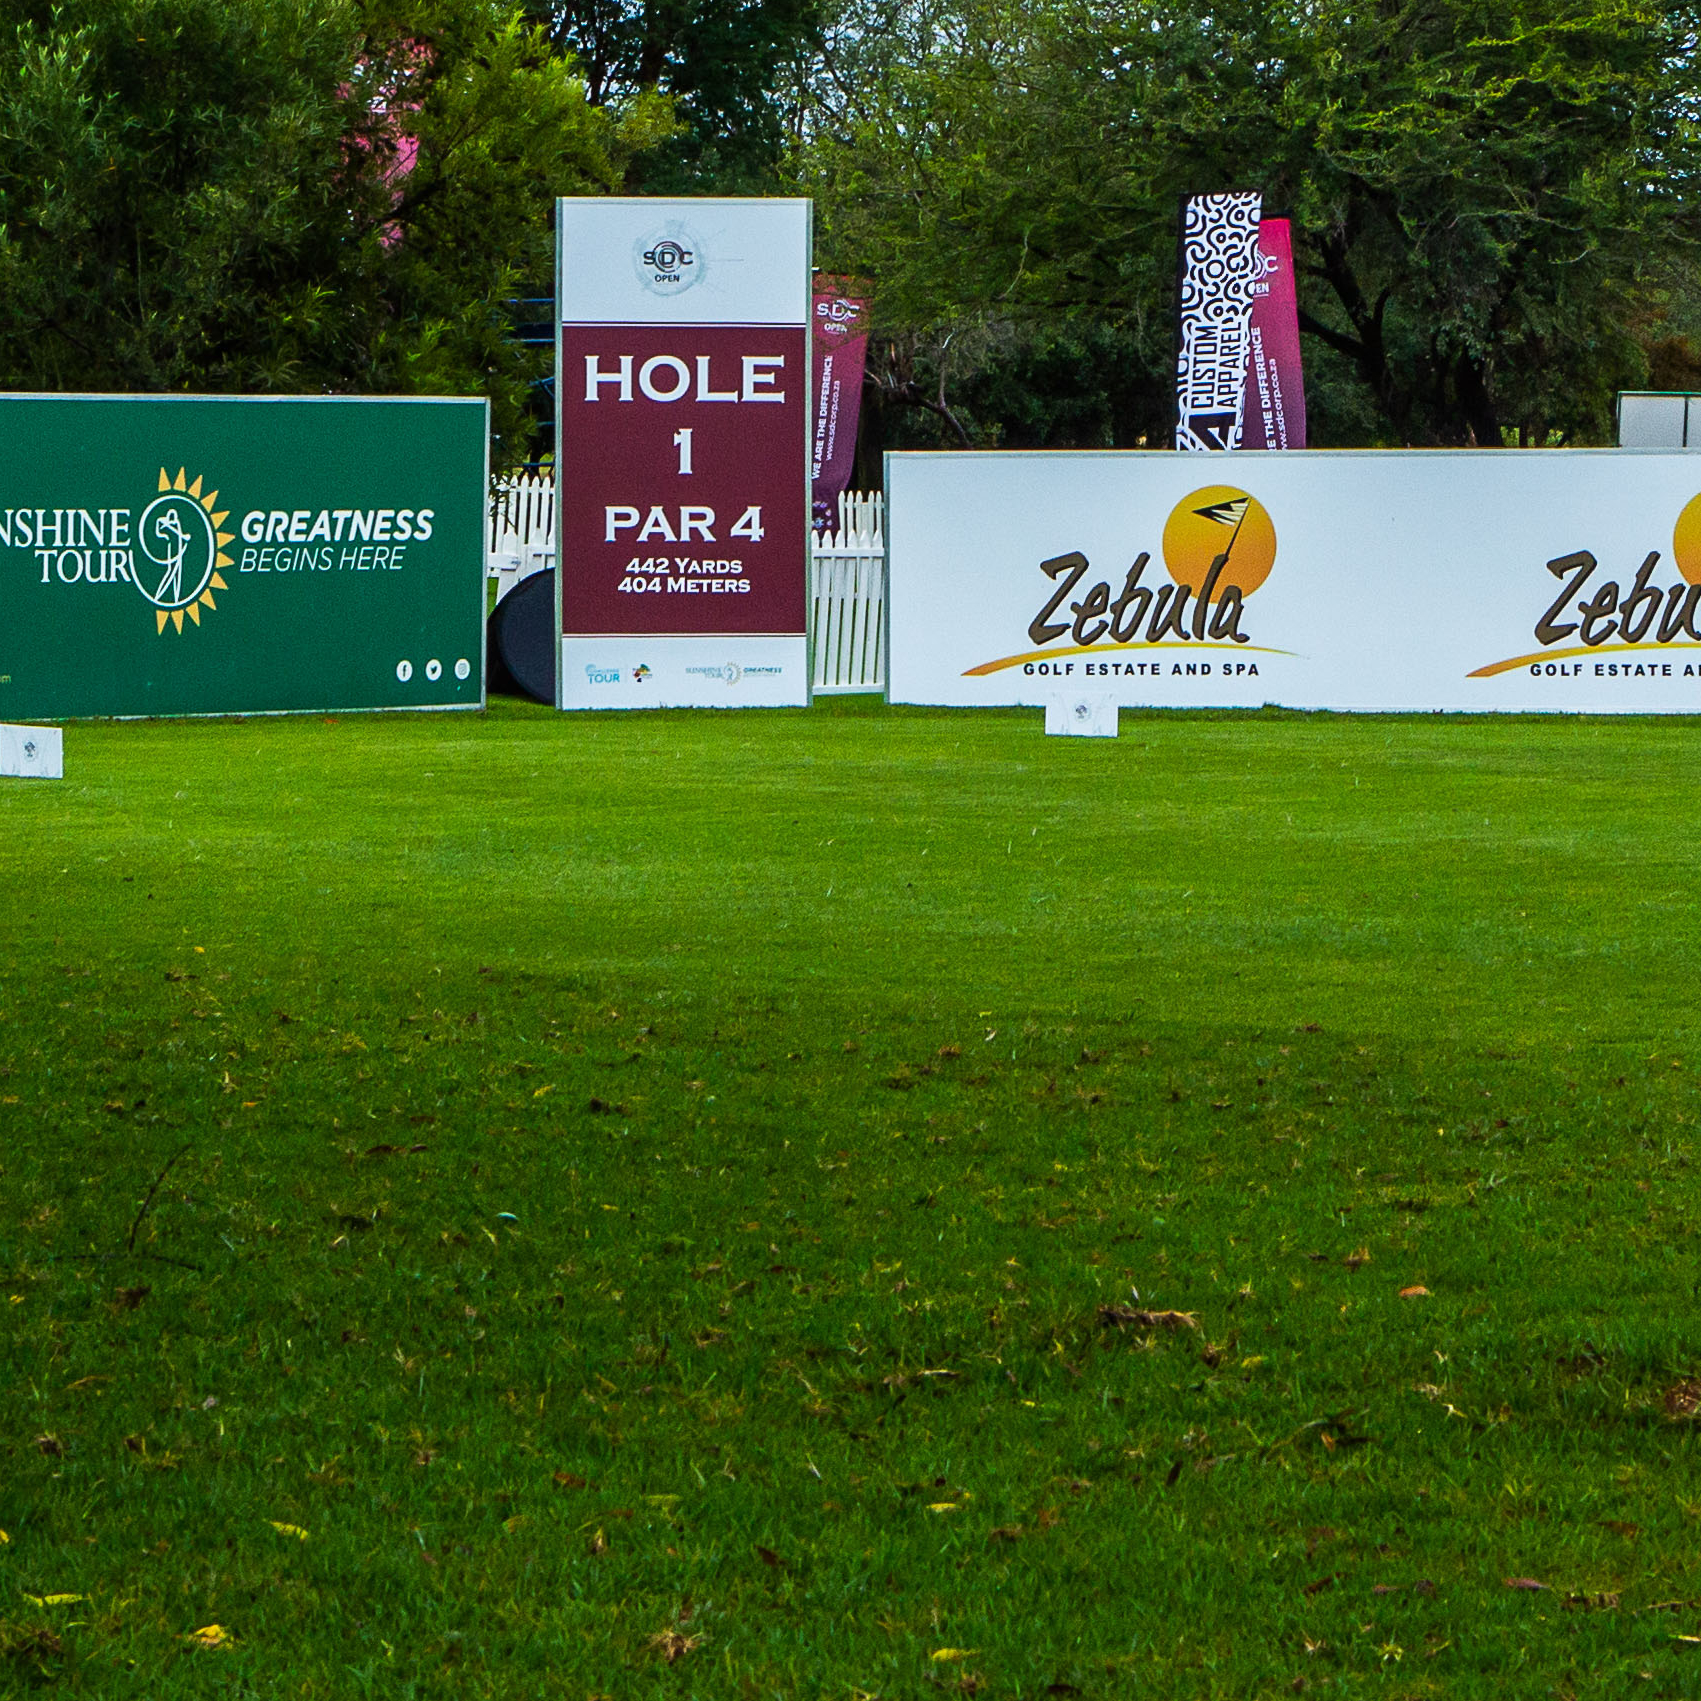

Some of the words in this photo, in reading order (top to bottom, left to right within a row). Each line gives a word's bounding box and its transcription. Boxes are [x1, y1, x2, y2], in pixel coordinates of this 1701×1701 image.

[654, 274, 680, 283] OPEN
[584, 354, 785, 404] HOLE
[1191, 325, 1218, 409] CUSTOM
[1217, 322, 1241, 408] APPAREL
[1251, 326, 1272, 409] DIFFERENCE
[820, 355, 833, 417] DIFFERENCE
[817, 418, 827, 438] THE
[1262, 410, 1275, 438] THE
[673, 428, 693, 475] 1
[814, 440, 825, 461] ARE
[811, 462, 822, 480] WE
[241, 509, 435, 544] GREATNESS
[604, 505, 716, 542] PAR
[730, 505, 764, 542] 4
[34, 549, 132, 583] TOUR
[240, 546, 334, 572] BEGINS
[339, 546, 407, 571] HERE
[625, 557, 670, 574] 442
[674, 557, 743, 574] YARDS
[617, 576, 662, 593] 404
[667, 576, 751, 593] METERS
[1028, 551, 1250, 646] Zebula
[587, 673, 620, 684] TOUR
[1023, 663, 1075, 676] GOLF
[1085, 663, 1161, 676] ESTATE
[1171, 663, 1212, 676] AND
[1222, 663, 1260, 676] SPA
[1530, 664, 1584, 677] GOLF
[1594, 664, 1673, 677] ESTATE
